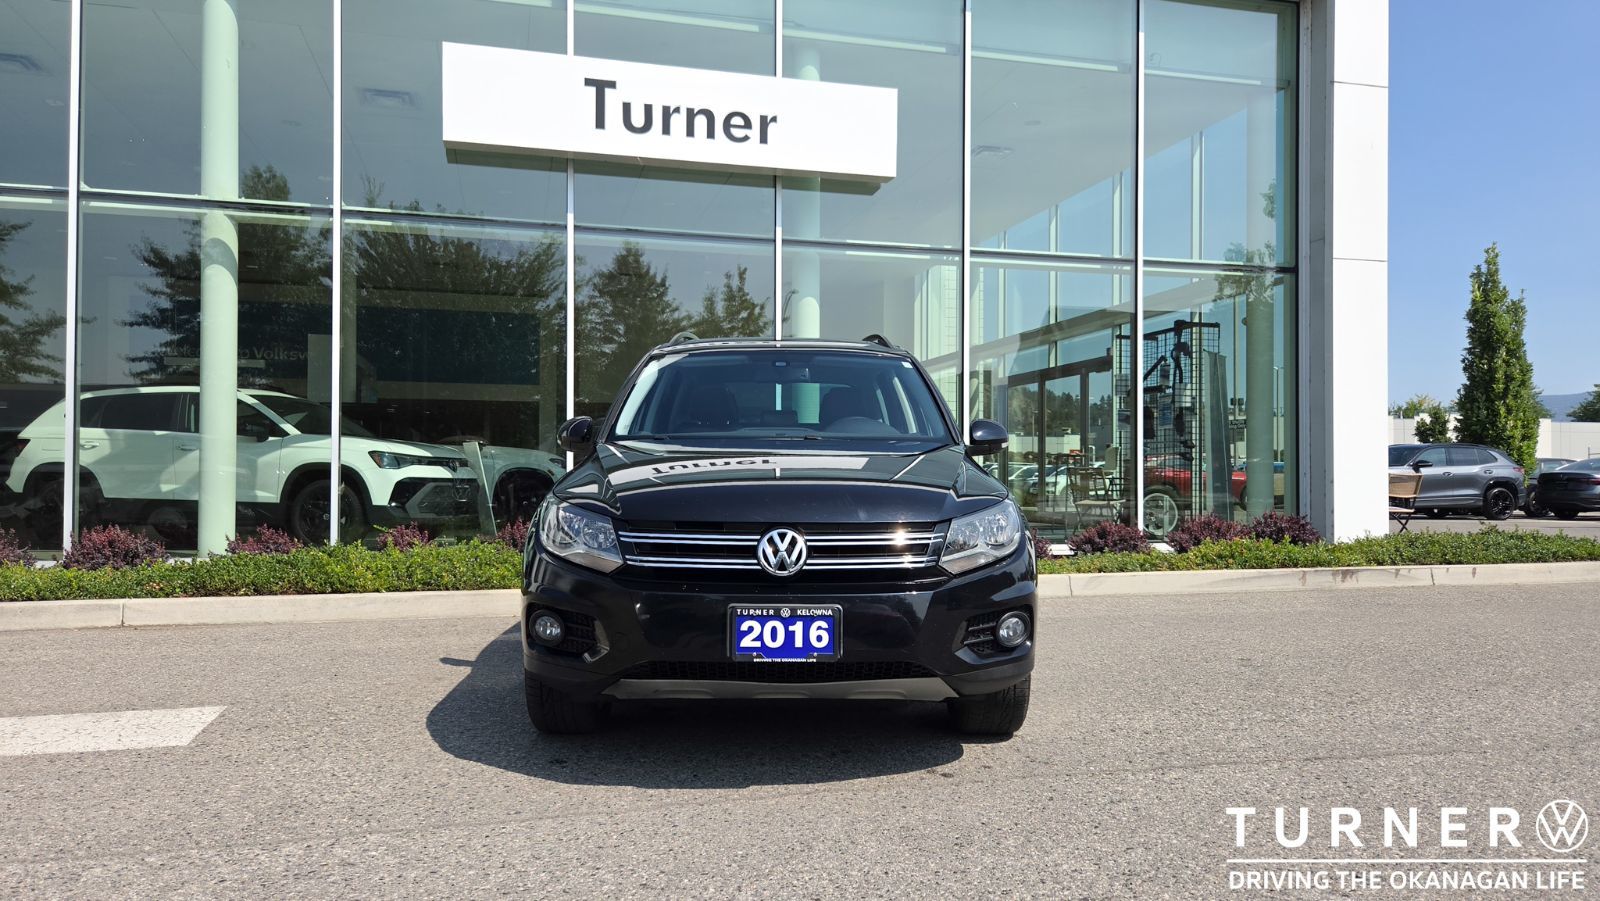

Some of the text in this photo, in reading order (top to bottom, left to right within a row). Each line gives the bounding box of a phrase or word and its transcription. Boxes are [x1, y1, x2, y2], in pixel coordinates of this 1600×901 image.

[584, 77, 778, 145] Turner
[252, 346, 308, 360] Volksw
[758, 529, 807, 576] VW
[736, 608, 775, 616] TURNER
[797, 608, 833, 616] KELOWNA
[740, 620, 829, 648] 2016
